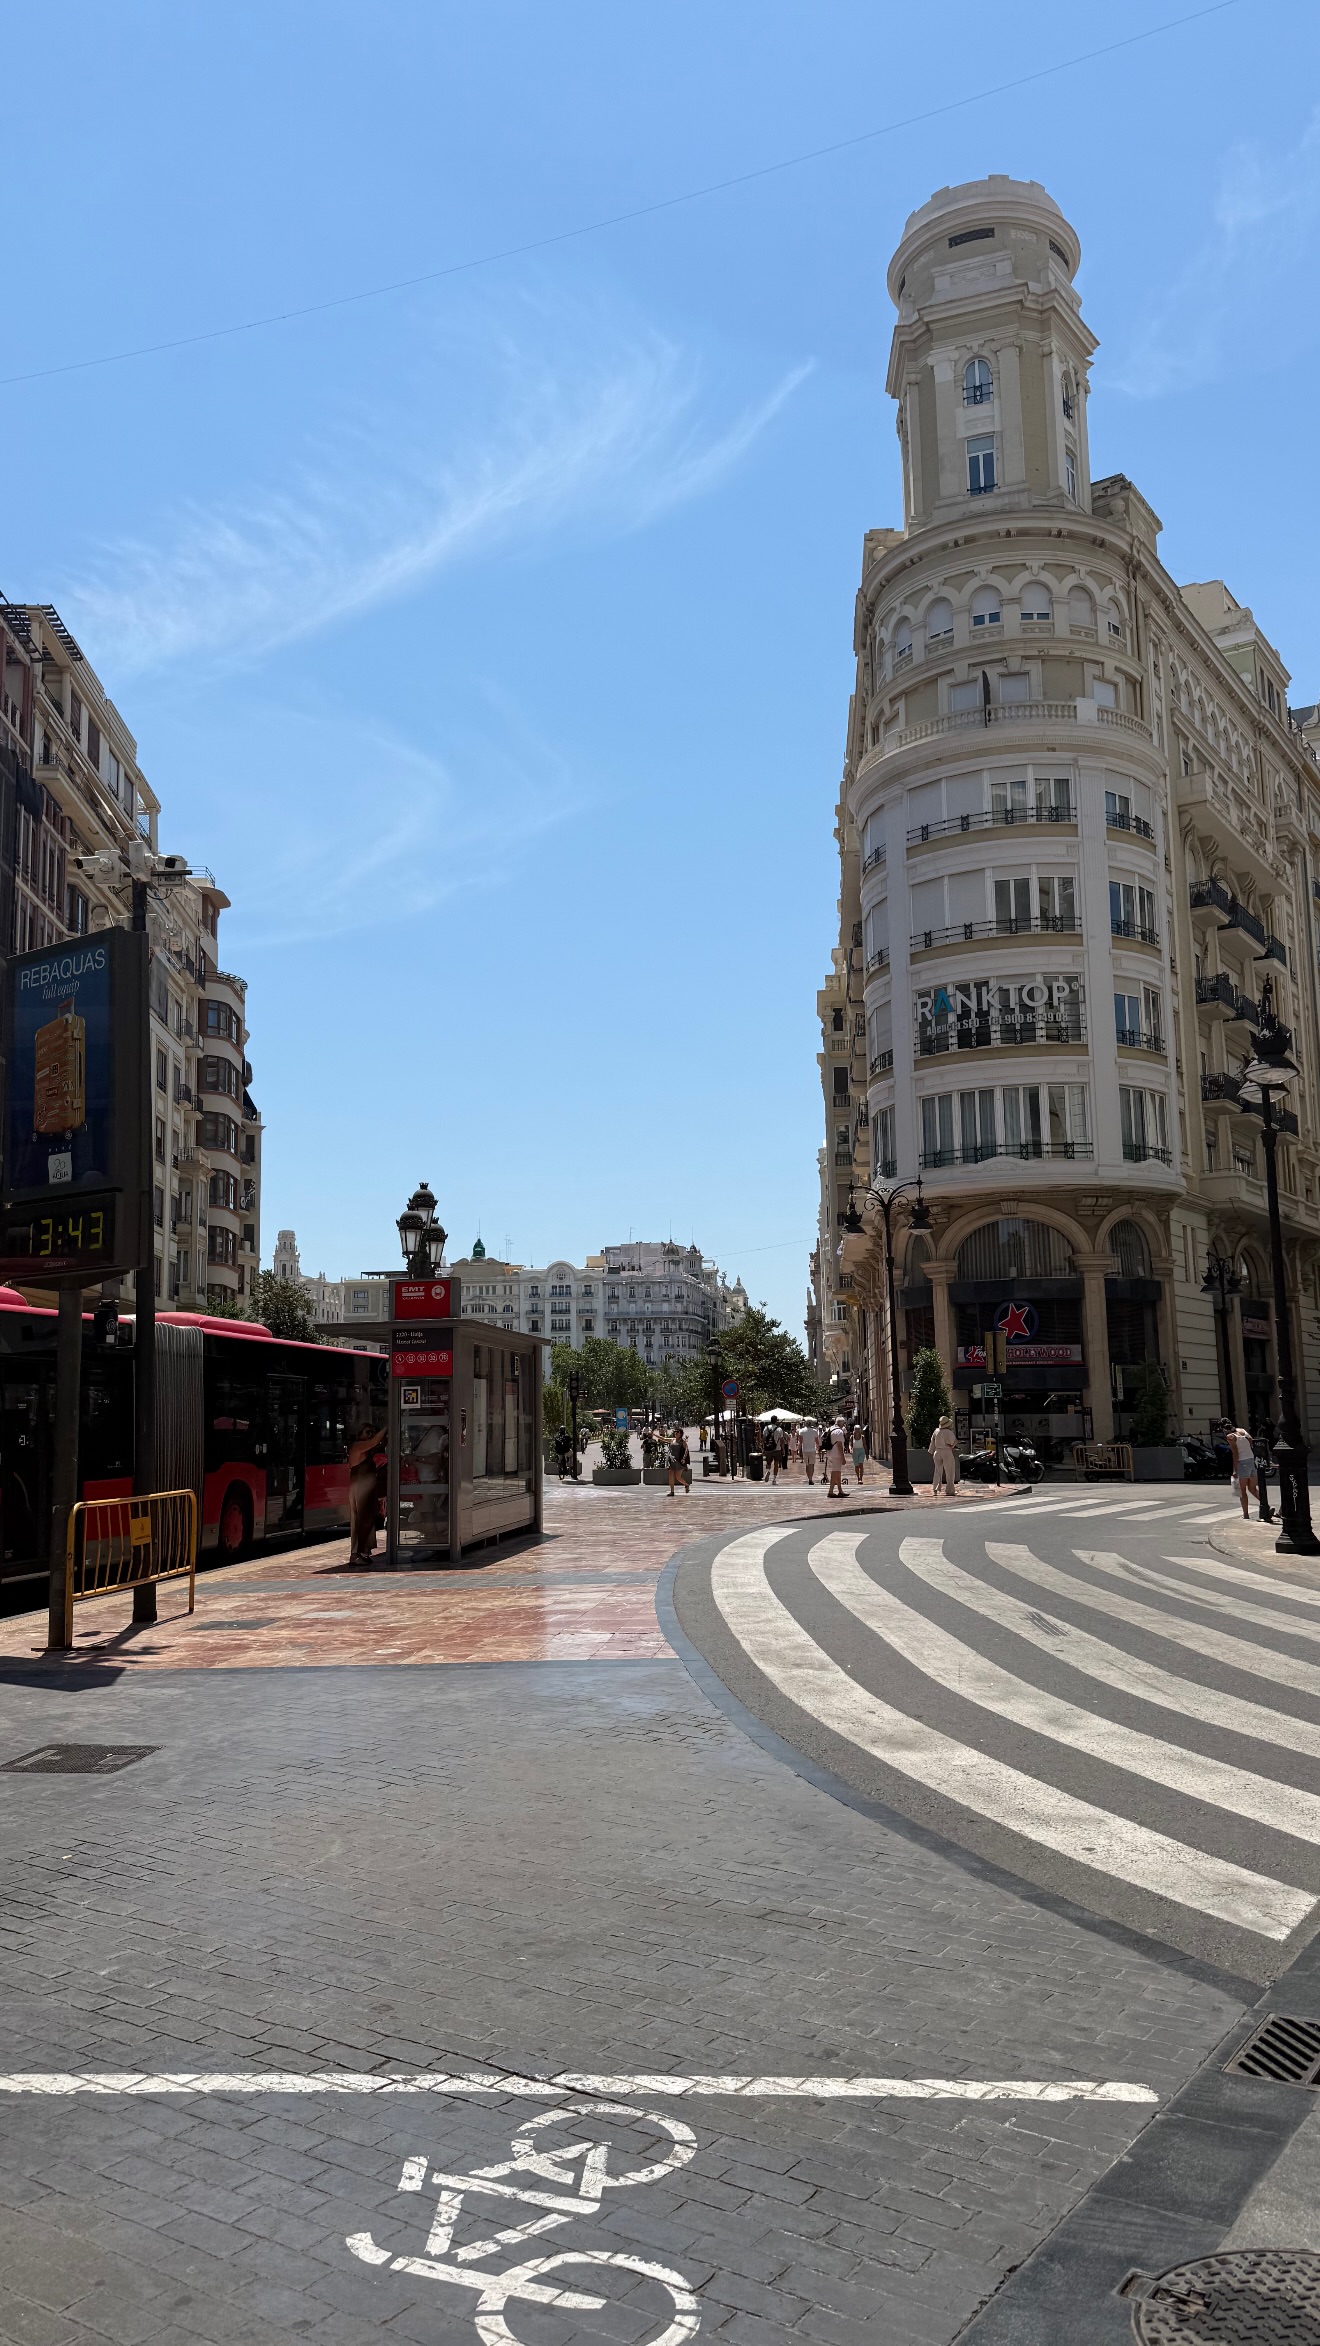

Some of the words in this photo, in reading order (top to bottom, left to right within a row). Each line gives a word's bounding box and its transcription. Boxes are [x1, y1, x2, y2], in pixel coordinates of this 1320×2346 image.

[20, 949, 105, 990] REBAQUAS
[42, 983, 57, 1000] full
[57, 979, 80, 998] equip
[926, 1021, 961, 1036] Agencia
[964, 1017, 980, 1030] SEO
[988, 1015, 1002, 1027] Tel
[1004, 1013, 1024, 1024] 900
[1026, 1012, 1039, 1023] 83
[1042, 1012, 1054, 1022] 49
[1056, 1012, 1068, 1021] 08
[29, 1211, 104, 1256] 13:43
[973, 1349, 987, 1358] Fos
[1007, 1347, 1072, 1358] HOLLYWOOD
